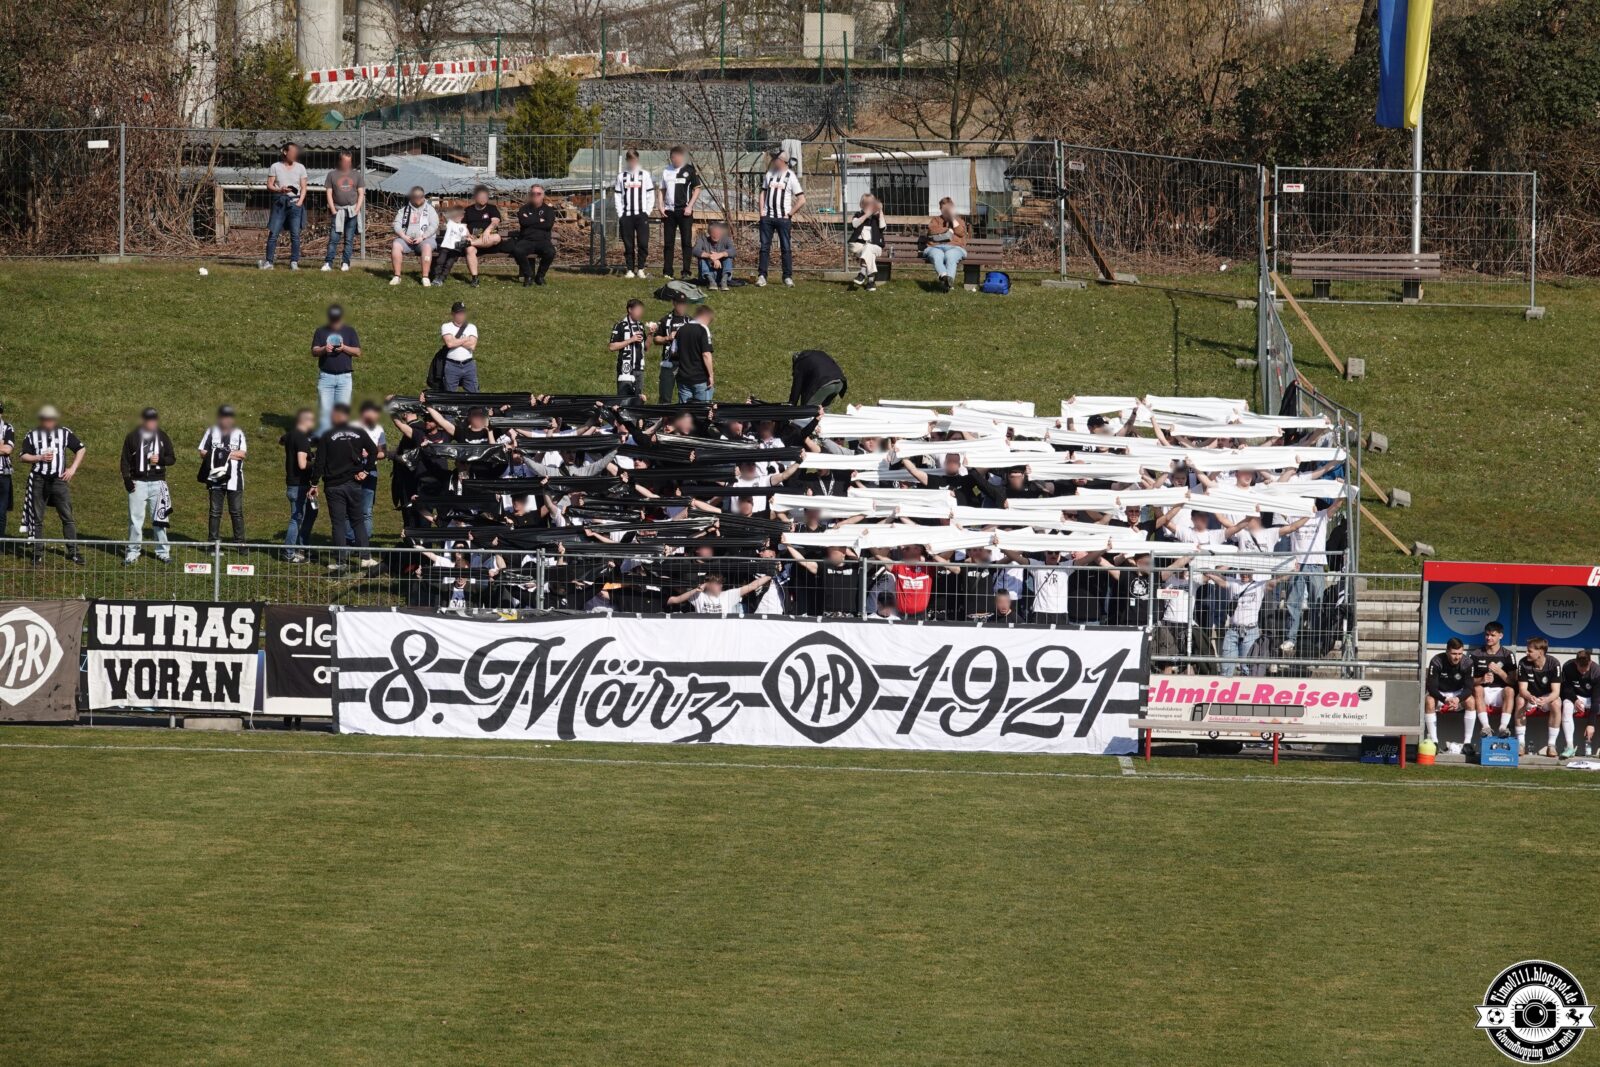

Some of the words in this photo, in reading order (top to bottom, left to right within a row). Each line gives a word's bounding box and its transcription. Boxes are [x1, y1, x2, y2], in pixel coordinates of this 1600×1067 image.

[1448, 606, 1490, 616] TECHNIK
[1450, 596, 1489, 605] STARKE
[1546, 599, 1578, 608] TEAM-
[1546, 610, 1578, 619] SPIRIT
[95, 603, 256, 650] ULTRAS
[104, 658, 243, 704] VORAN
[369, 629, 444, 725] 8.
[463, 635, 742, 743] März
[896, 644, 1131, 738] 1921
